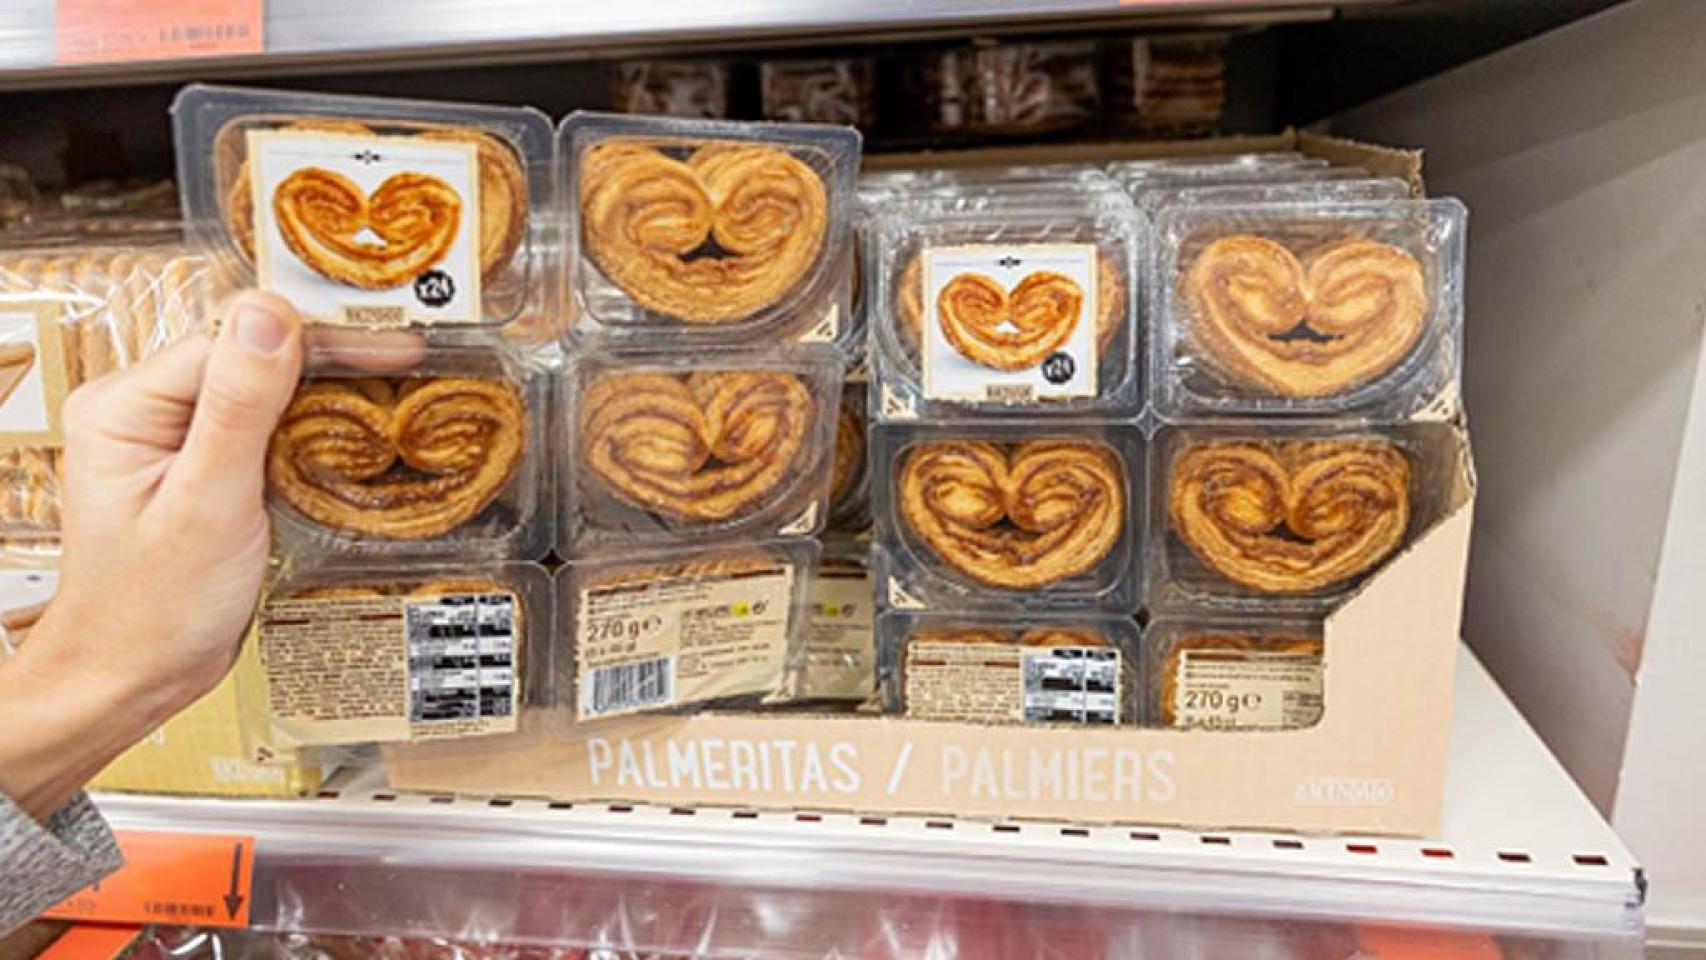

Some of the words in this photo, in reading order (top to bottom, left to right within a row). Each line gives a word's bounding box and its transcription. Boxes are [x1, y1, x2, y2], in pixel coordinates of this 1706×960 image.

[586, 619, 624, 644] 270
[628, 620, 640, 641] g
[1185, 690, 1223, 709] 270
[1226, 694, 1240, 713] g
[586, 737, 863, 796] PALMERITAS
[885, 741, 914, 796] /
[941, 744, 1177, 802] PALMIERS
